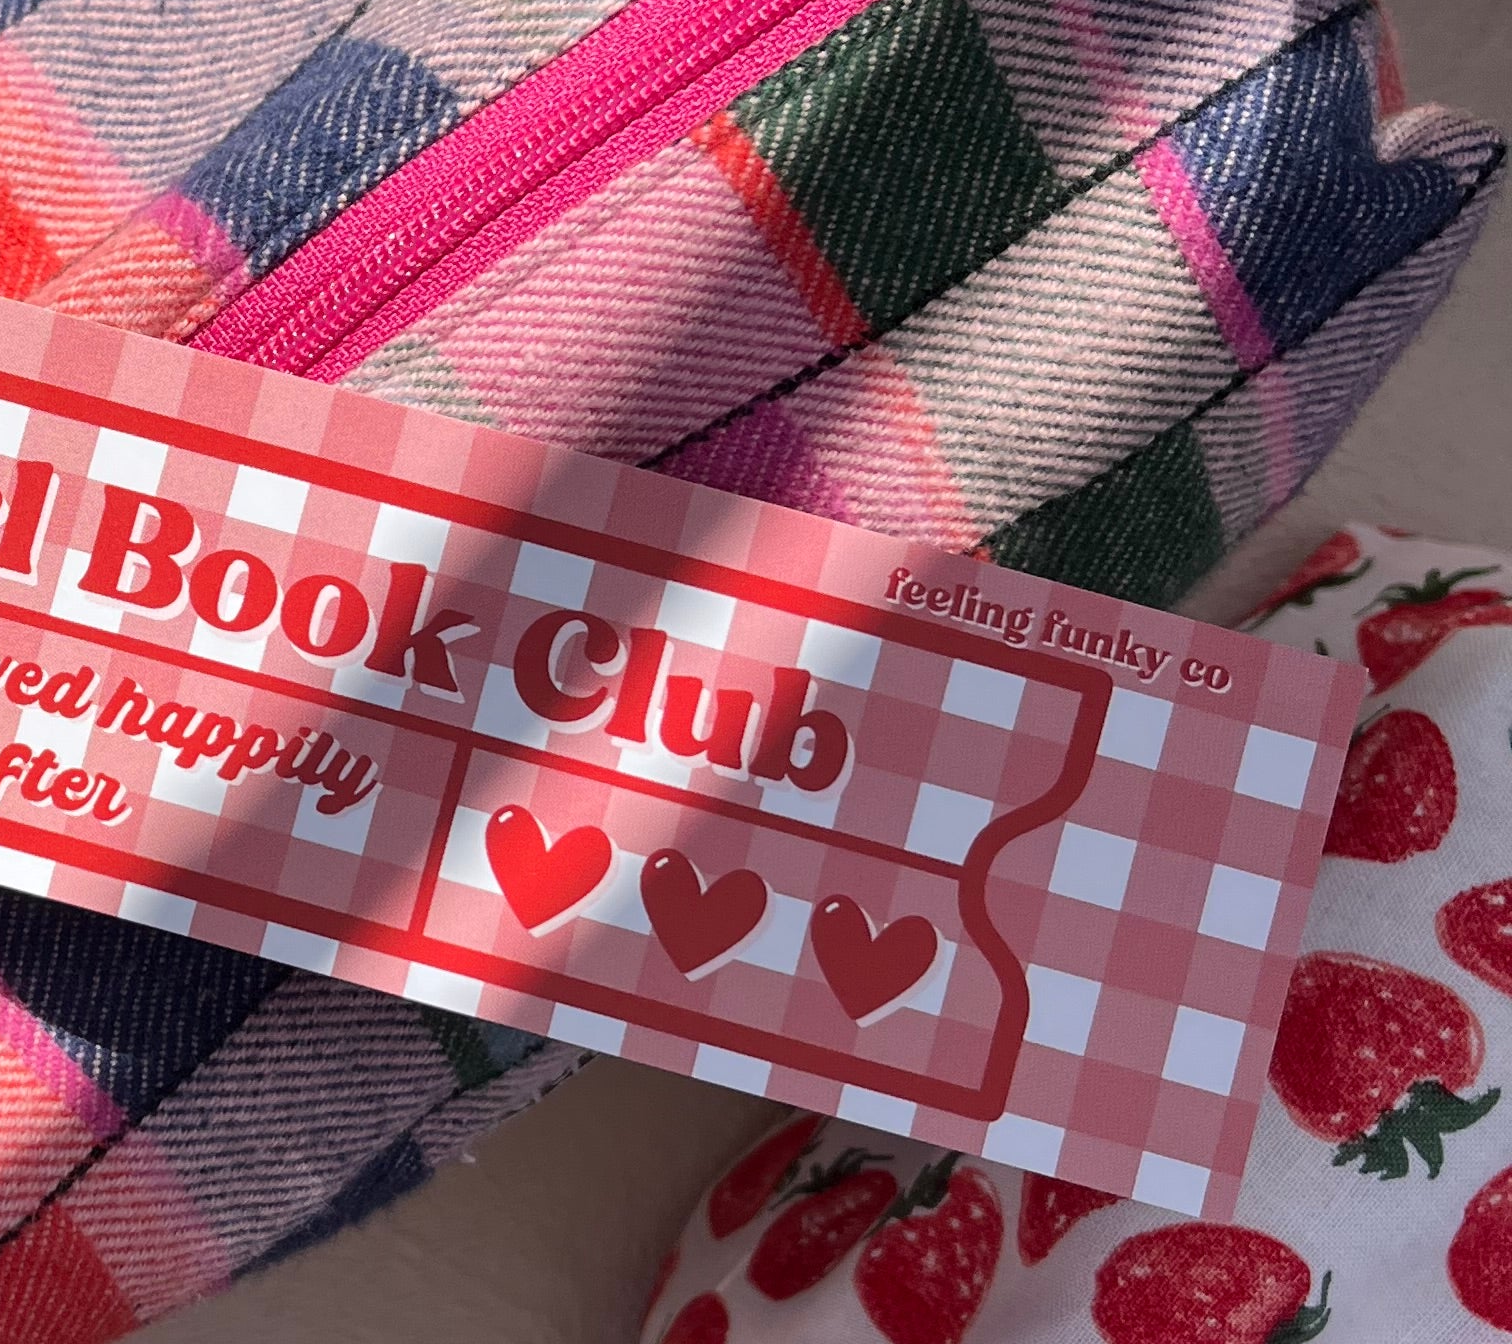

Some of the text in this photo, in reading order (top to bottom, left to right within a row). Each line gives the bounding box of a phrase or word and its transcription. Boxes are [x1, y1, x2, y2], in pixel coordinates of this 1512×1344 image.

[78, 483, 476, 694] Book
[512, 609, 850, 794] Club
[884, 567, 1231, 690] feeling funky co
[96, 677, 377, 815] happily
